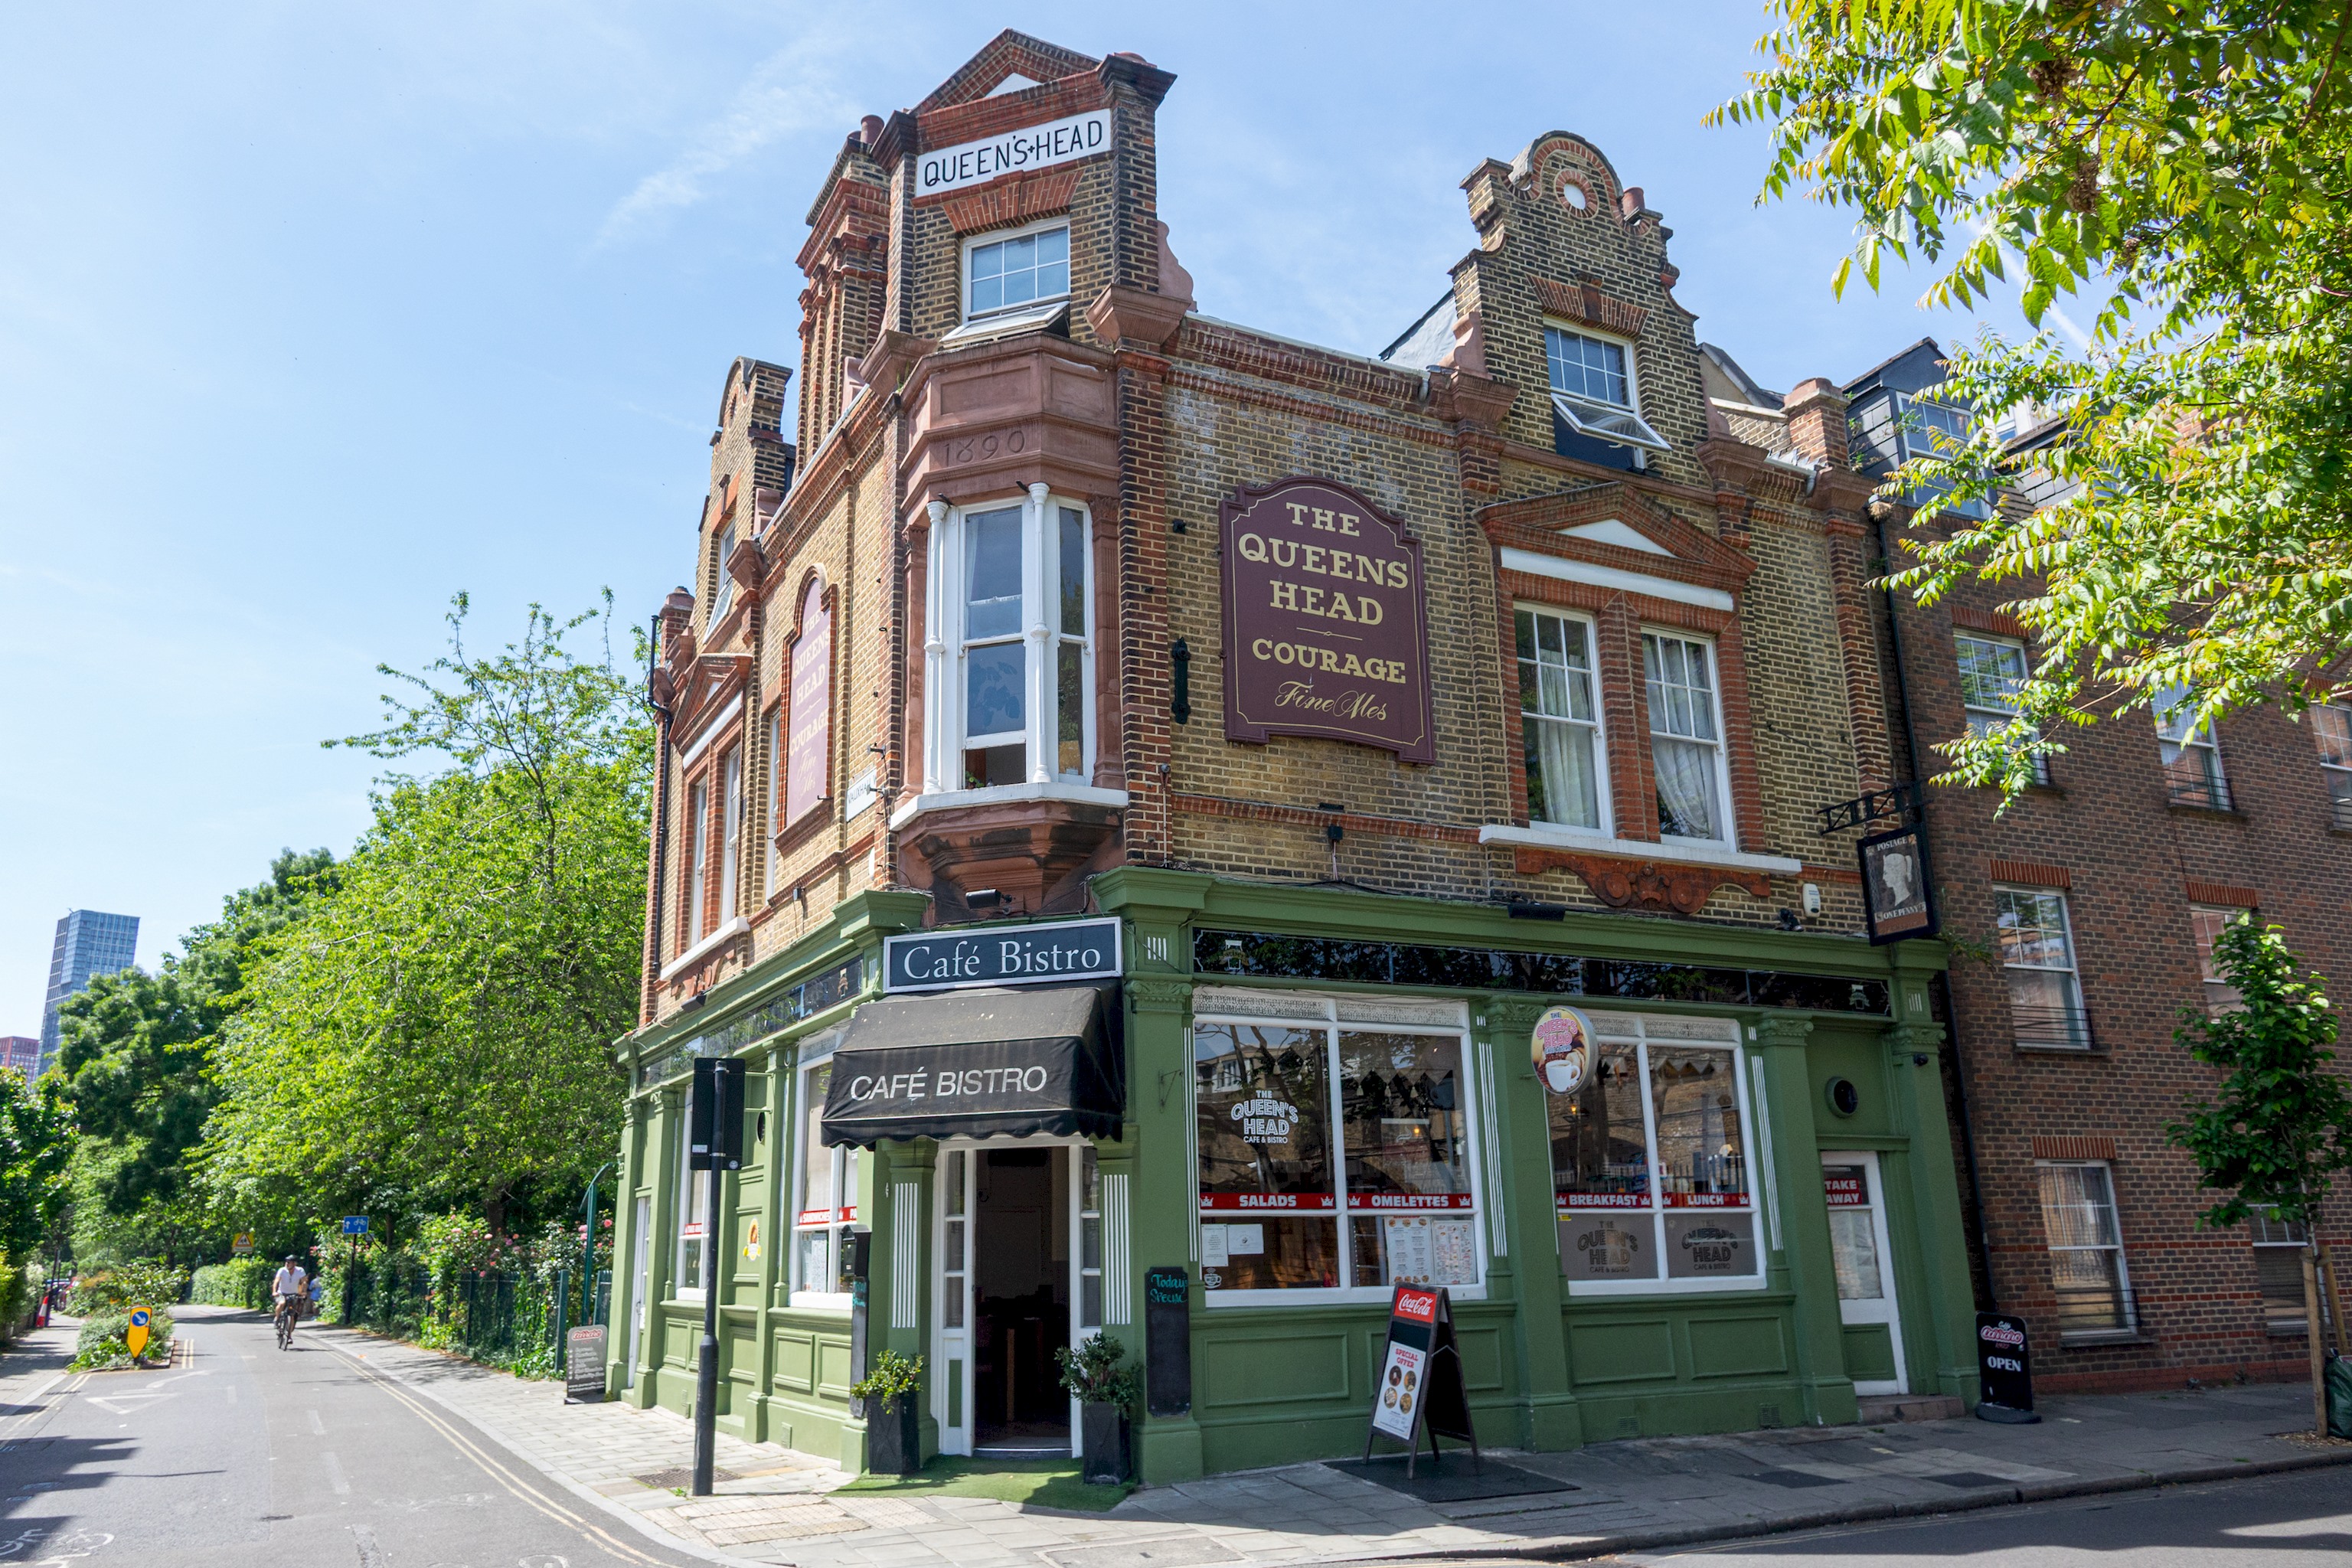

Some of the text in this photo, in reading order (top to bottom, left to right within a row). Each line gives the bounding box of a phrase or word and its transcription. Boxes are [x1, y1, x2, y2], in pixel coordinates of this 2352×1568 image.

[924, 119, 1102, 187] QUEEN'S HEAD
[942, 430, 1025, 467] 1890
[1285, 501, 1361, 537] THE
[1238, 533, 1409, 589] QUEENS
[1269, 579, 1383, 626] HEAD
[804, 610, 821, 636] THE
[1252, 638, 1406, 684] COURAGE
[795, 663, 826, 707] HEAD
[1274, 680, 1387, 721] Fine Ales
[1877, 836, 1908, 851] POSTAGE
[1883, 909, 1898, 920] ONE
[1898, 904, 1919, 916] PENNY
[903, 940, 1101, 979] Café Bistro
[1537, 1018, 1578, 1039] QUEEN'S
[1544, 1032, 1573, 1048] HEAD
[851, 1065, 1048, 1102] CAFÉ BISTRO
[1256, 1089, 1273, 1098] THE
[1230, 1099, 1299, 1124] QUEEN'S
[1243, 1118, 1290, 1135] HEAD
[1243, 1135, 1260, 1144] CAFE
[1824, 1180, 1857, 1191] TAKE
[1239, 1194, 1297, 1207] SALADS
[1371, 1194, 1449, 1207] OMELETTES
[1569, 1194, 1638, 1206] BREAKFAST
[1687, 1194, 1724, 1206] LUNCH
[1826, 1193, 1860, 1204] AWAY
[1599, 1220, 1615, 1229] THE
[1577, 1229, 1638, 1253] QUEEN'S
[1589, 1249, 1630, 1265] HEAD
[1692, 1246, 1732, 1263] HEAD
[1395, 1348, 1419, 1361] SPECIAL
[1396, 1357, 1415, 1369] OFFER
[1987, 1356, 2021, 1372] OPEN
